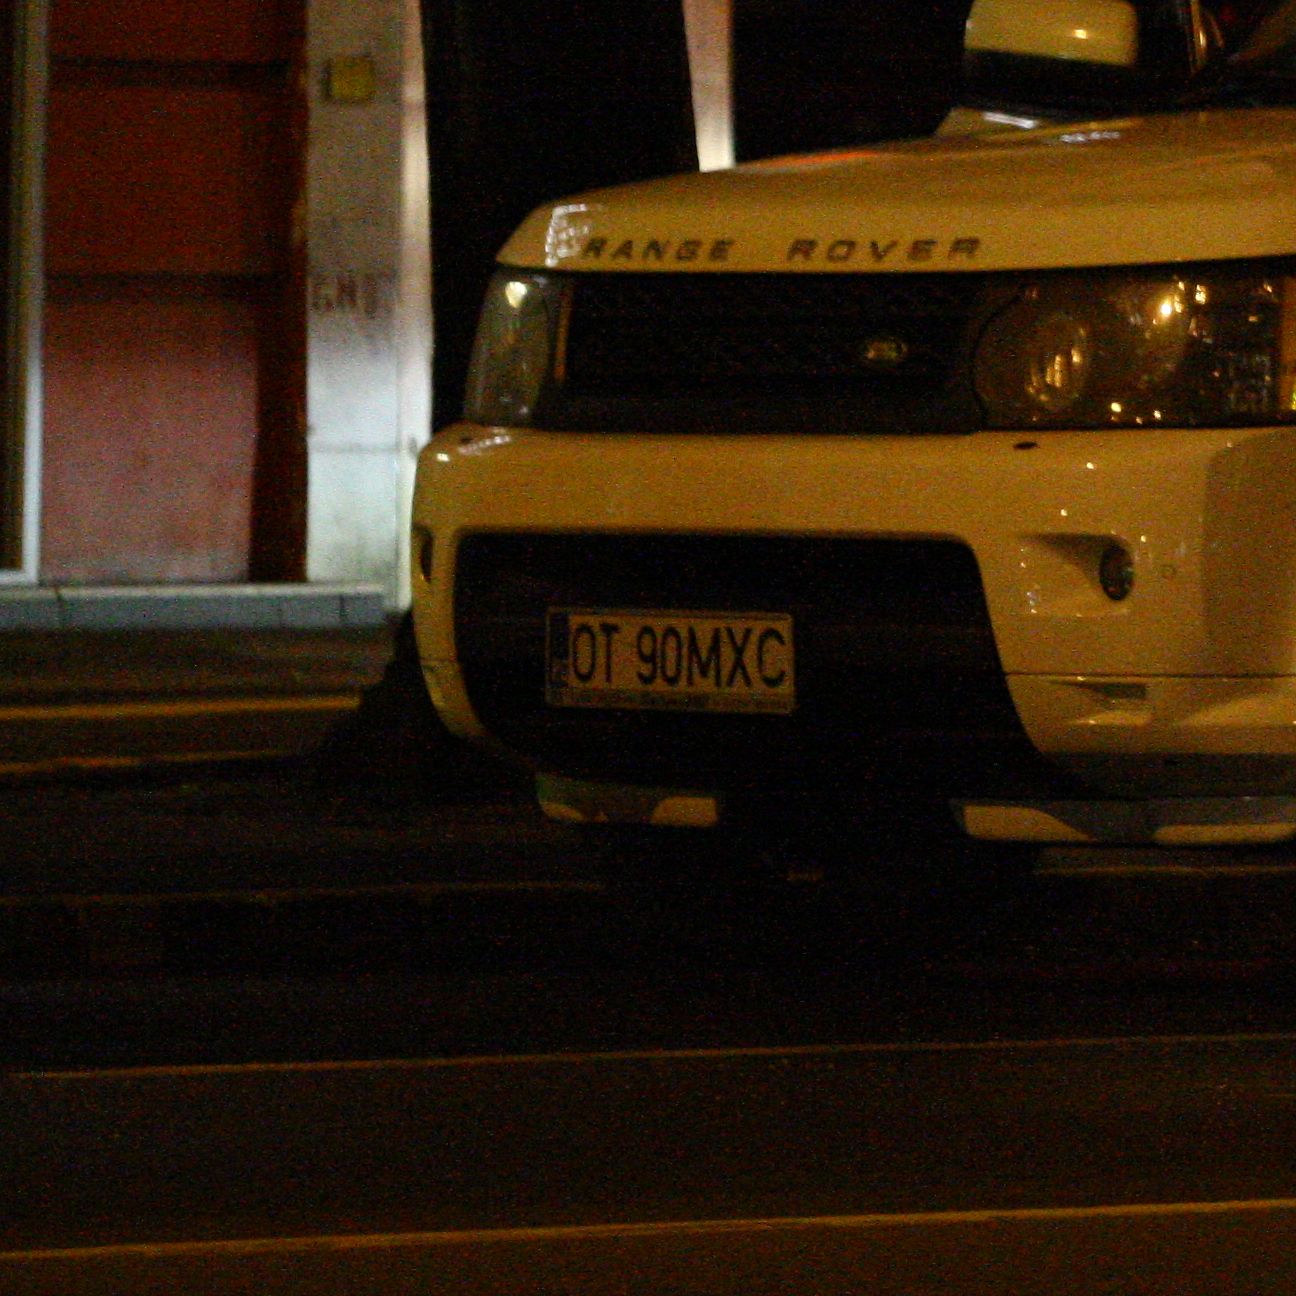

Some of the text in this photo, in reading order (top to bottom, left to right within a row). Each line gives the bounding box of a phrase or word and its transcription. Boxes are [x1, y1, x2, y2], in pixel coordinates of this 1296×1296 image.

[581, 236, 981, 262] RANGE ROVER
[573, 623, 619, 683] OT
